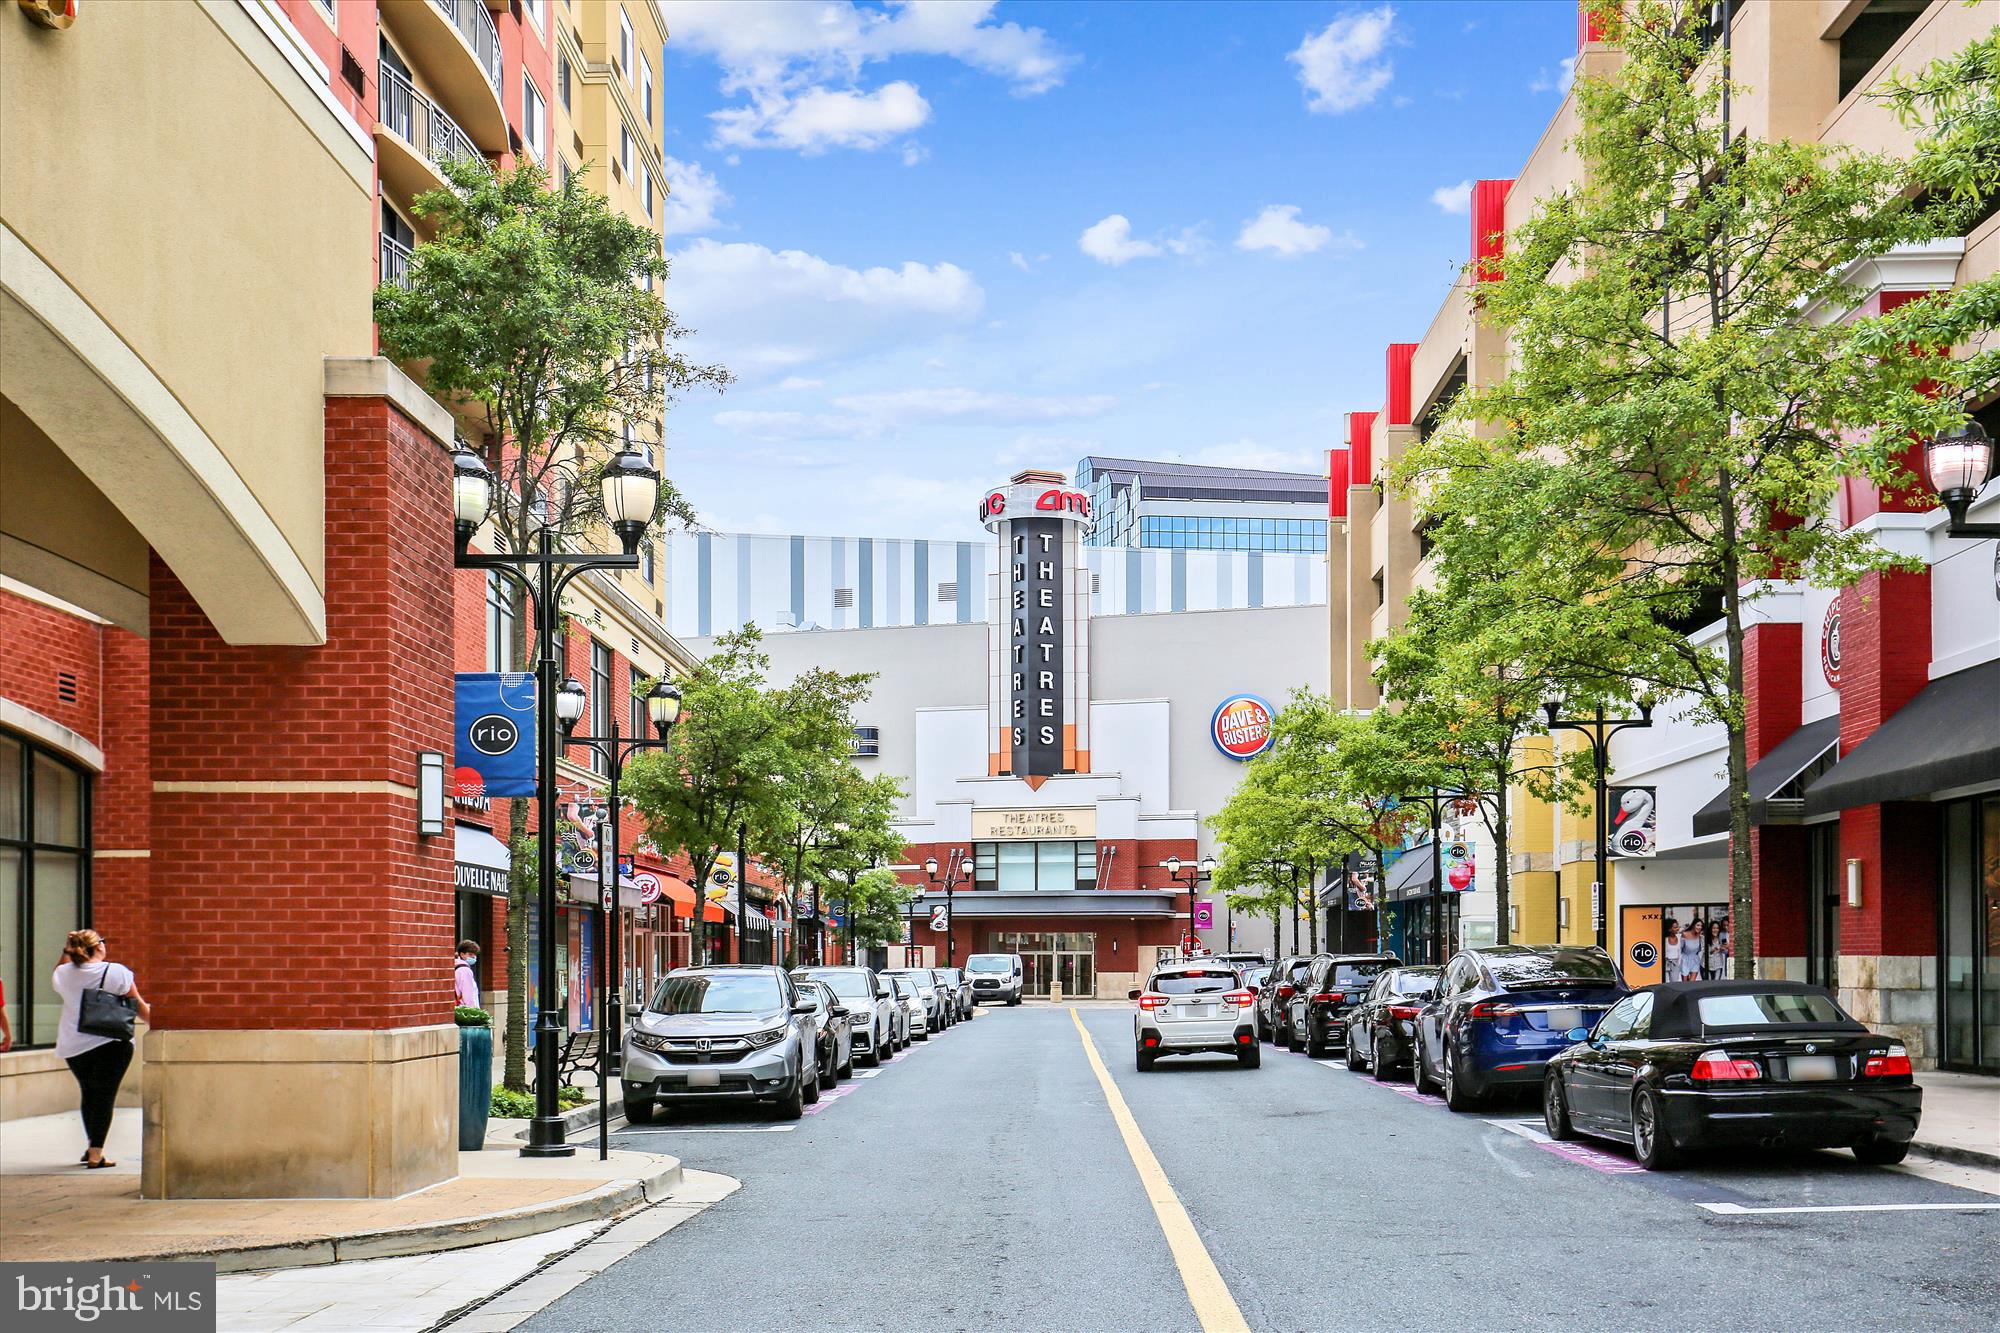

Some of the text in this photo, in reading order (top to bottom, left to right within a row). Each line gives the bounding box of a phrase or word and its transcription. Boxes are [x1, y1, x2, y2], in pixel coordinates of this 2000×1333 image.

[980, 493, 1005, 517] mc
[1013, 535, 1022, 747] THEATRES
[1039, 533, 1055, 745] THEATRES
[1221, 708, 1267, 732] DAVE &
[477, 725, 512, 741] rio
[1003, 812, 1066, 824] THEATRES
[990, 825, 1078, 837] RESTAURANTS
[1623, 838, 1642, 847] rio
[576, 854, 593, 863] rio
[454, 865, 489, 889] OUVELLE
[714, 872, 729, 880] rio
[1183, 942, 1201, 950] TP
[1634, 948, 1653, 957] rio
